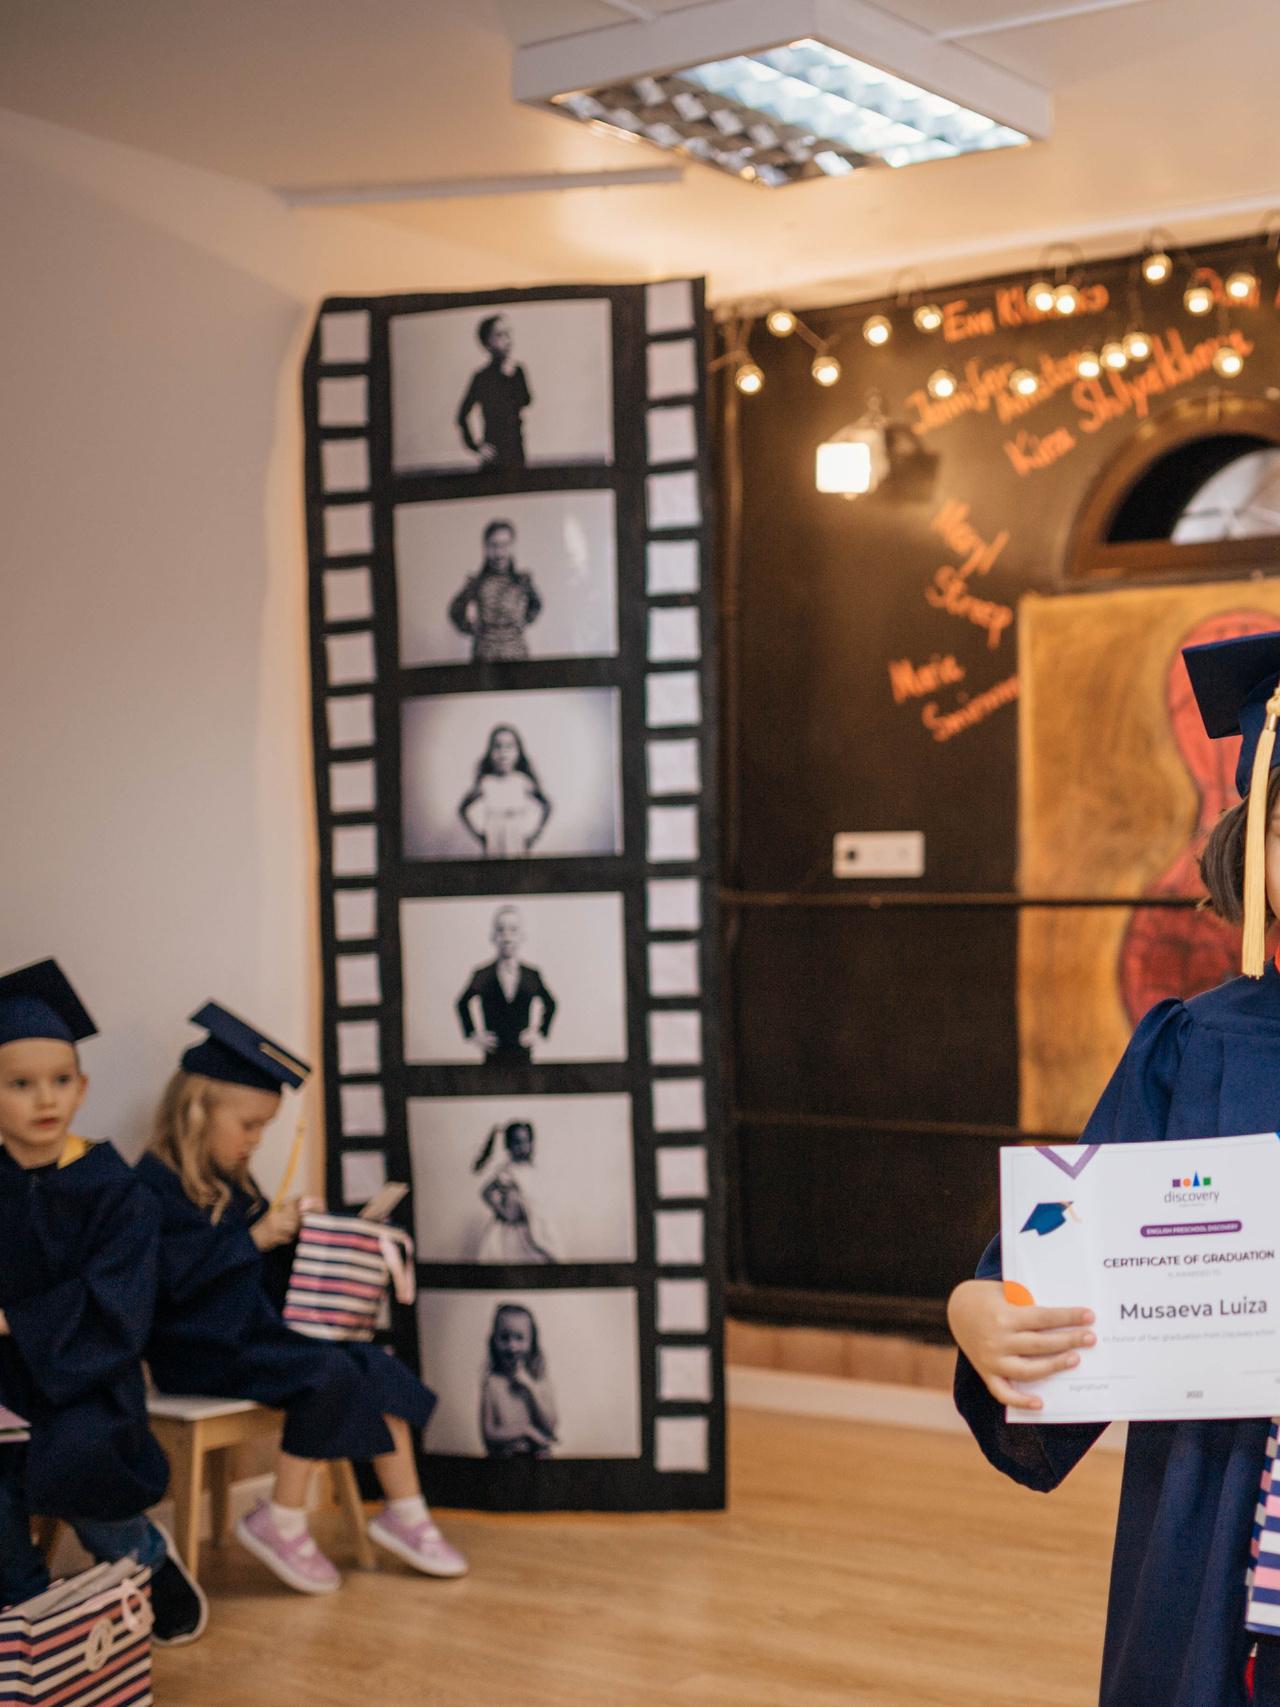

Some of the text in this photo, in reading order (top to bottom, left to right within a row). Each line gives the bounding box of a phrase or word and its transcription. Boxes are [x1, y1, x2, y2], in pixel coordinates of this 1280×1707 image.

[1163, 1190, 1220, 1203] discovery
[1146, 1223, 1239, 1235] ENGLISH PRESCHOOL DISCOVERY
[1103, 1250, 1275, 1268] CERTIFICATE OF GRADUATION
[1120, 1296, 1268, 1320] Musaeva Luiza
